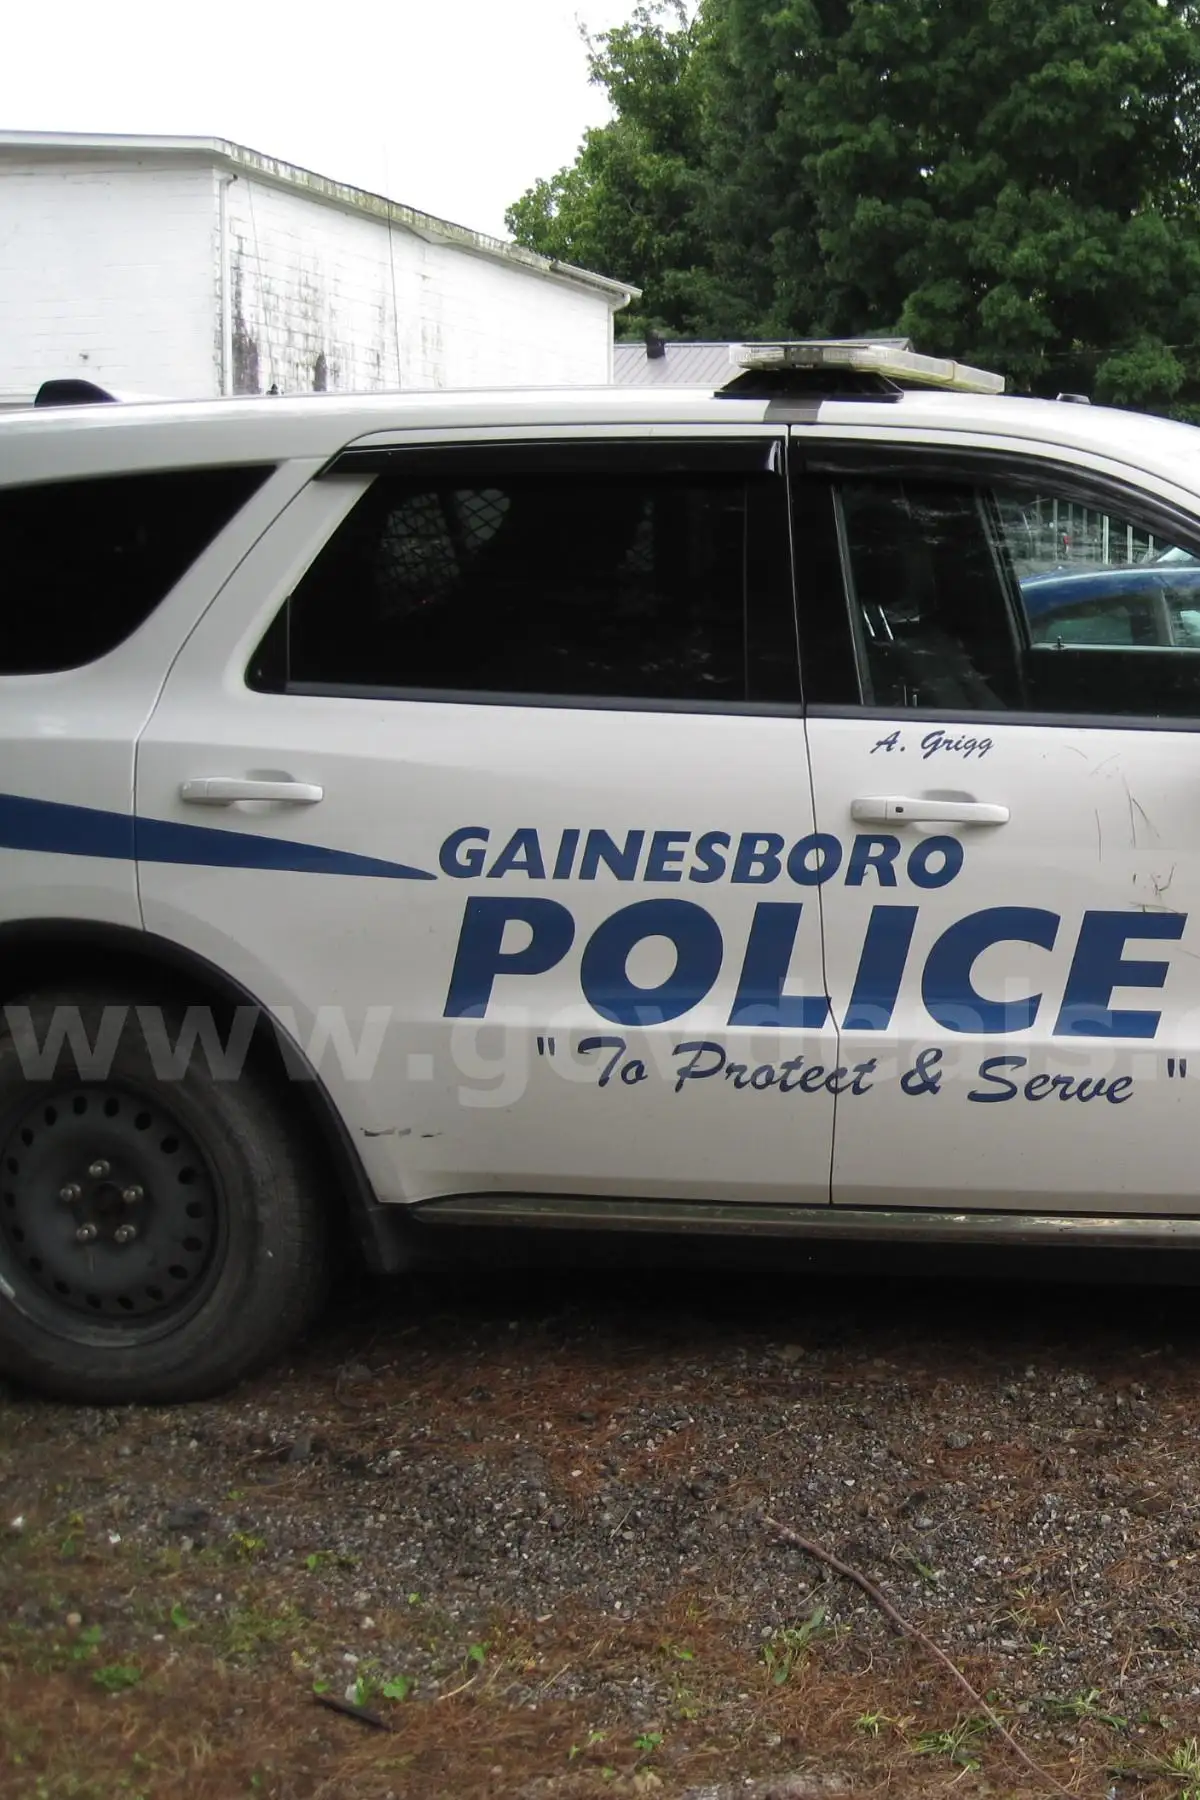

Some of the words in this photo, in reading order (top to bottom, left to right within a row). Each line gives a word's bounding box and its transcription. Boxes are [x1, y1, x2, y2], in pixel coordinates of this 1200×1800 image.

[870, 730, 905, 754] A.
[920, 730, 993, 759] Grigg
[438, 826, 965, 890] GAINESBORO
[442, 896, 1188, 1039] POLICE
[577, 1036, 649, 1087] To
[673, 1040, 874, 1094] Protect
[900, 1048, 943, 1097] &
[967, 1056, 1134, 1105] Serve
